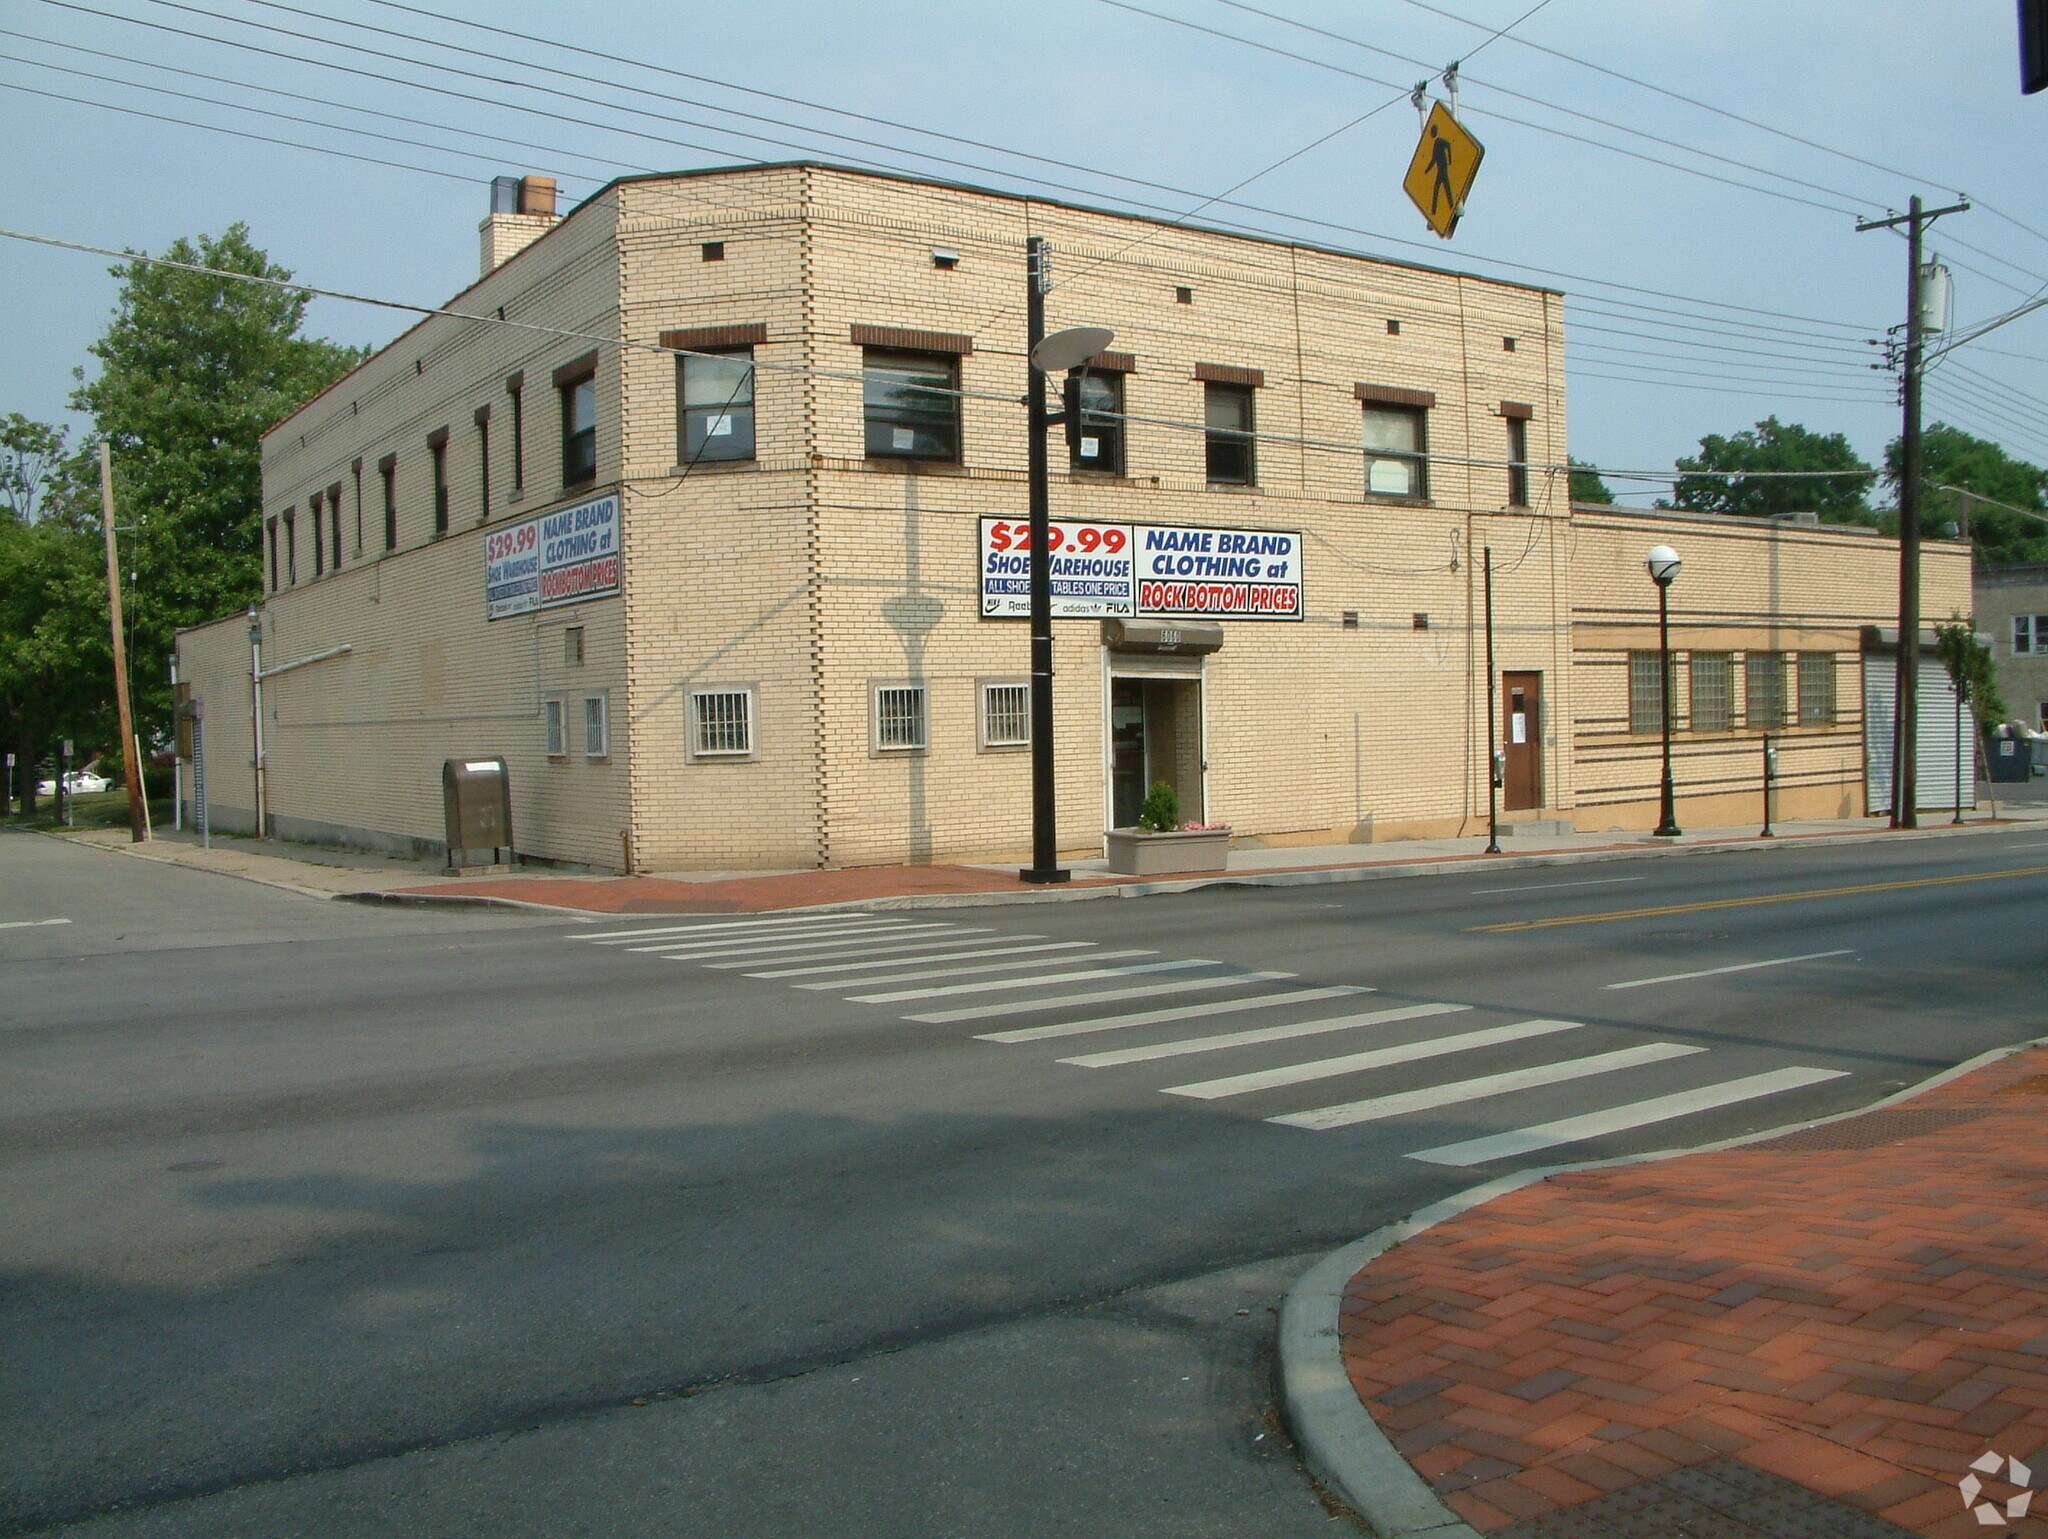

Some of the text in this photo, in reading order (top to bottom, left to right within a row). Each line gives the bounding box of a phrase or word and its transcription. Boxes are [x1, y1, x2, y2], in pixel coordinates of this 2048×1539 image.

[543, 500, 613, 541] NAME BRAND
[488, 525, 536, 563] $29.99
[546, 528, 612, 564] CLOTHING at
[989, 521, 1126, 554] $29.99
[1145, 530, 1292, 556] NAME BRAND
[986, 552, 1031, 574] SHOE
[1152, 554, 1289, 578] CLOTHING at
[988, 580, 1004, 594] ALL
[1052, 581, 1086, 595] TABLES
[1086, 583, 1103, 595] ONE
[1103, 583, 1128, 596] PRICE
[1140, 580, 1298, 611] ROCK BOTTOM PRICES
[1063, 604, 1090, 613] adidas
[1106, 603, 1130, 613] FILA
